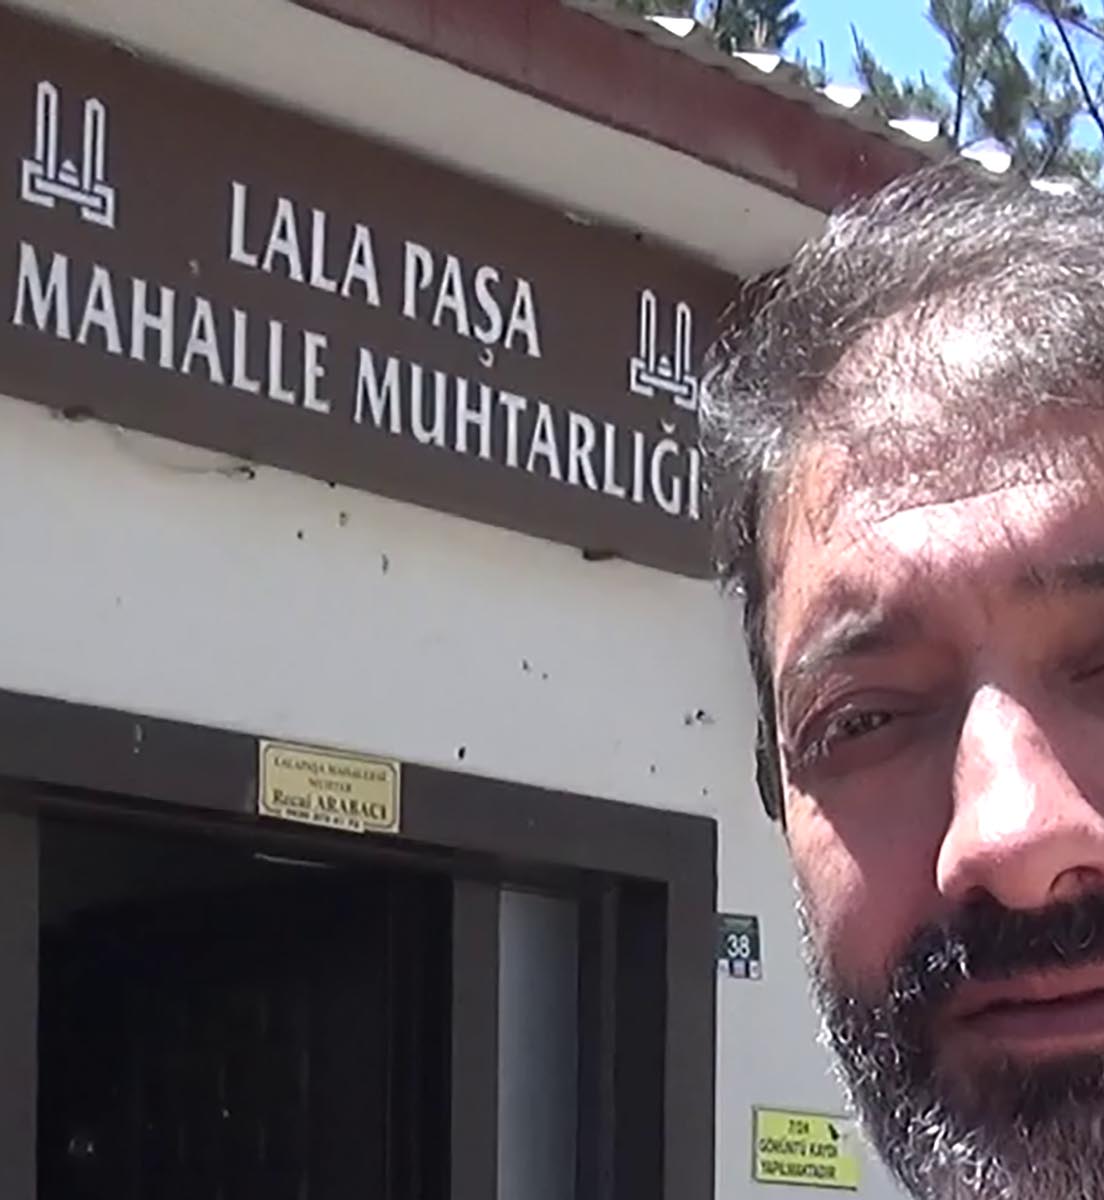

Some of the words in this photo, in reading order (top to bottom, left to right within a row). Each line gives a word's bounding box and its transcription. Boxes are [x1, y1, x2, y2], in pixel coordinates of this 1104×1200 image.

[229, 180, 381, 307] LALA
[402, 239, 542, 367] PAŞA
[12, 241, 331, 414] MAHALLE
[354, 347, 700, 520] MUHTARLIĞI
[317, 795, 387, 820] ARABACI
[727, 933, 751, 958] 38
